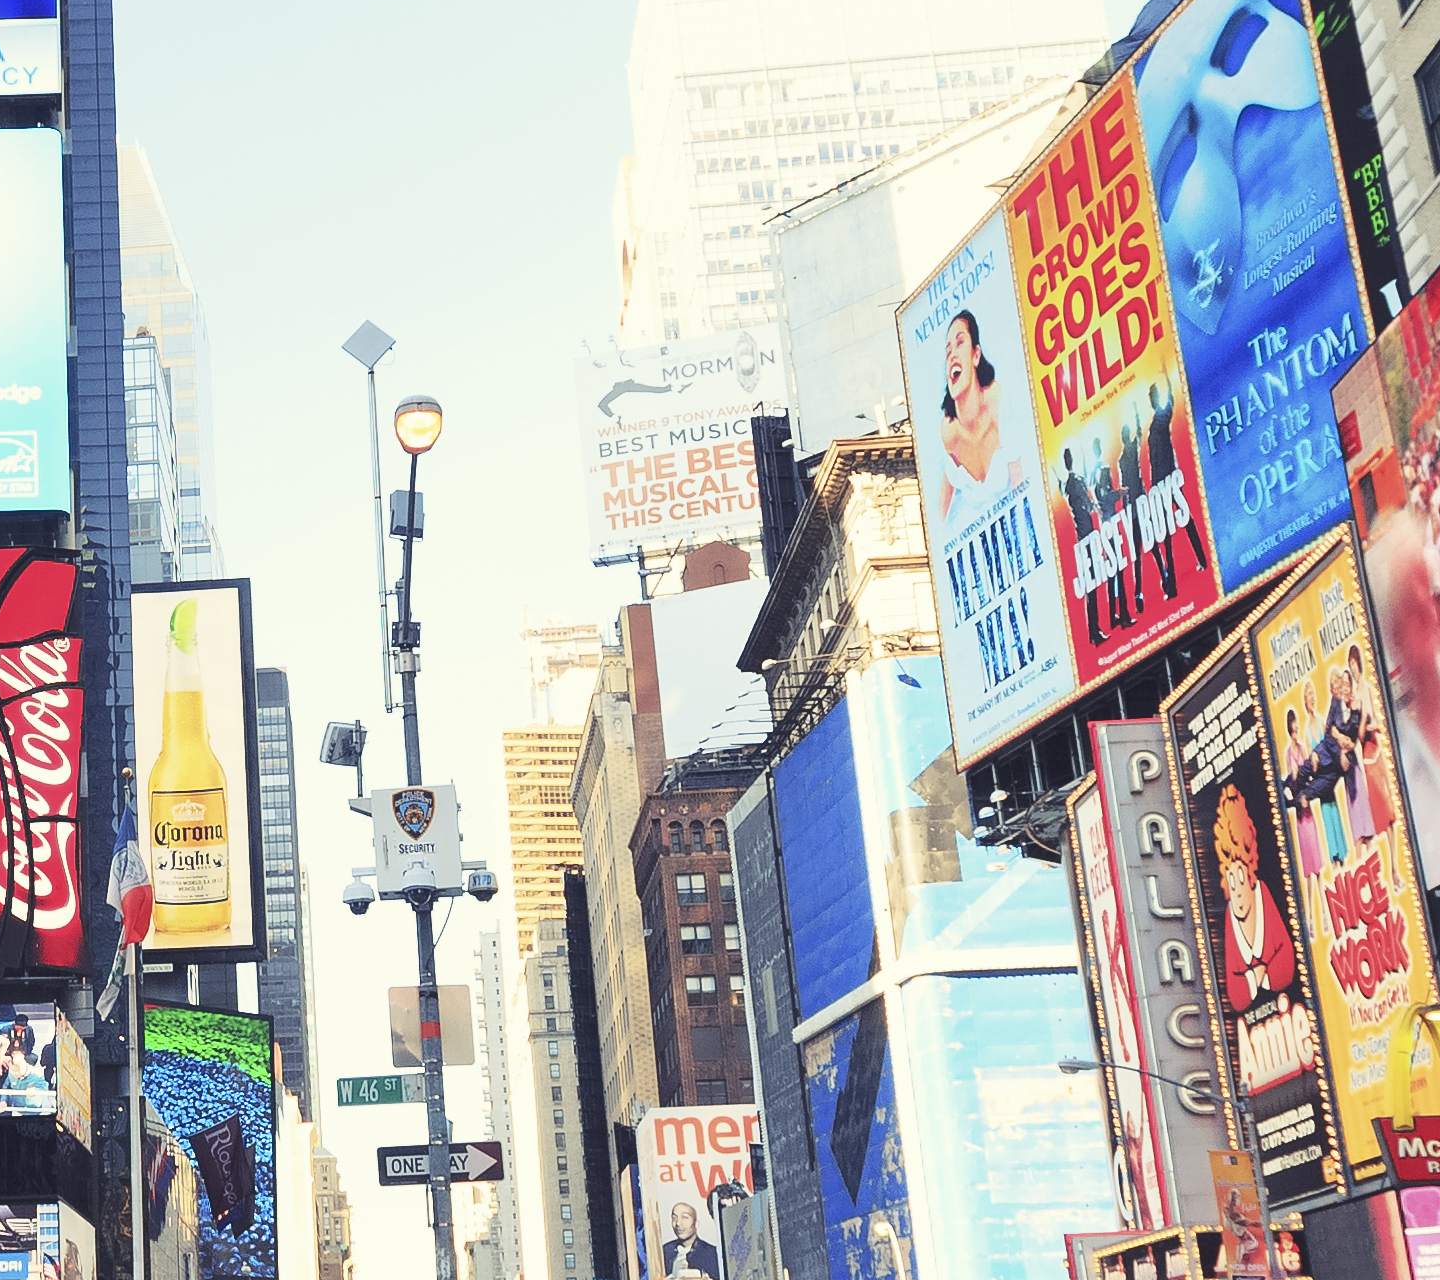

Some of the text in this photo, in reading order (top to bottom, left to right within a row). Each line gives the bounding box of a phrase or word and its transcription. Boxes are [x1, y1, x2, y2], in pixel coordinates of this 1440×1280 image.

[1026, 172, 1140, 307] CROWD
[1243, 201, 1338, 291] Longest-Running
[1256, 189, 1317, 253] Broadway's
[951, 242, 974, 281] FUN
[1272, 246, 1316, 298] Musical
[915, 250, 995, 348] NEVER STOPS!
[1034, 222, 1151, 365] GOES
[1248, 324, 1288, 368] The
[1205, 312, 1358, 457] PHANTOM
[597, 410, 714, 439] WINNER 9 TONY
[598, 436, 663, 459] BEST
[1260, 429, 1278, 455] of
[603, 475, 741, 512] MUSICAL
[1239, 424, 1343, 516] OPERA
[605, 507, 665, 532] THIS
[1073, 469, 1189, 600] JERSEY BOYS
[946, 496, 1044, 629] MAMMA
[975, 586, 1036, 694] MIA!
[1319, 603, 1358, 656] MUELLER
[1269, 640, 1316, 701] BRODERICK
[155, 822, 224, 848] Corona
[170, 850, 210, 870] Light
[1326, 851, 1390, 938] NICE
[1330, 909, 1409, 999] WORK
[1238, 993, 1314, 1091] Annie
[340, 1078, 398, 1103] W 46 ST
[391, 1157, 425, 1174] ONE
[660, 1162, 686, 1182] at
